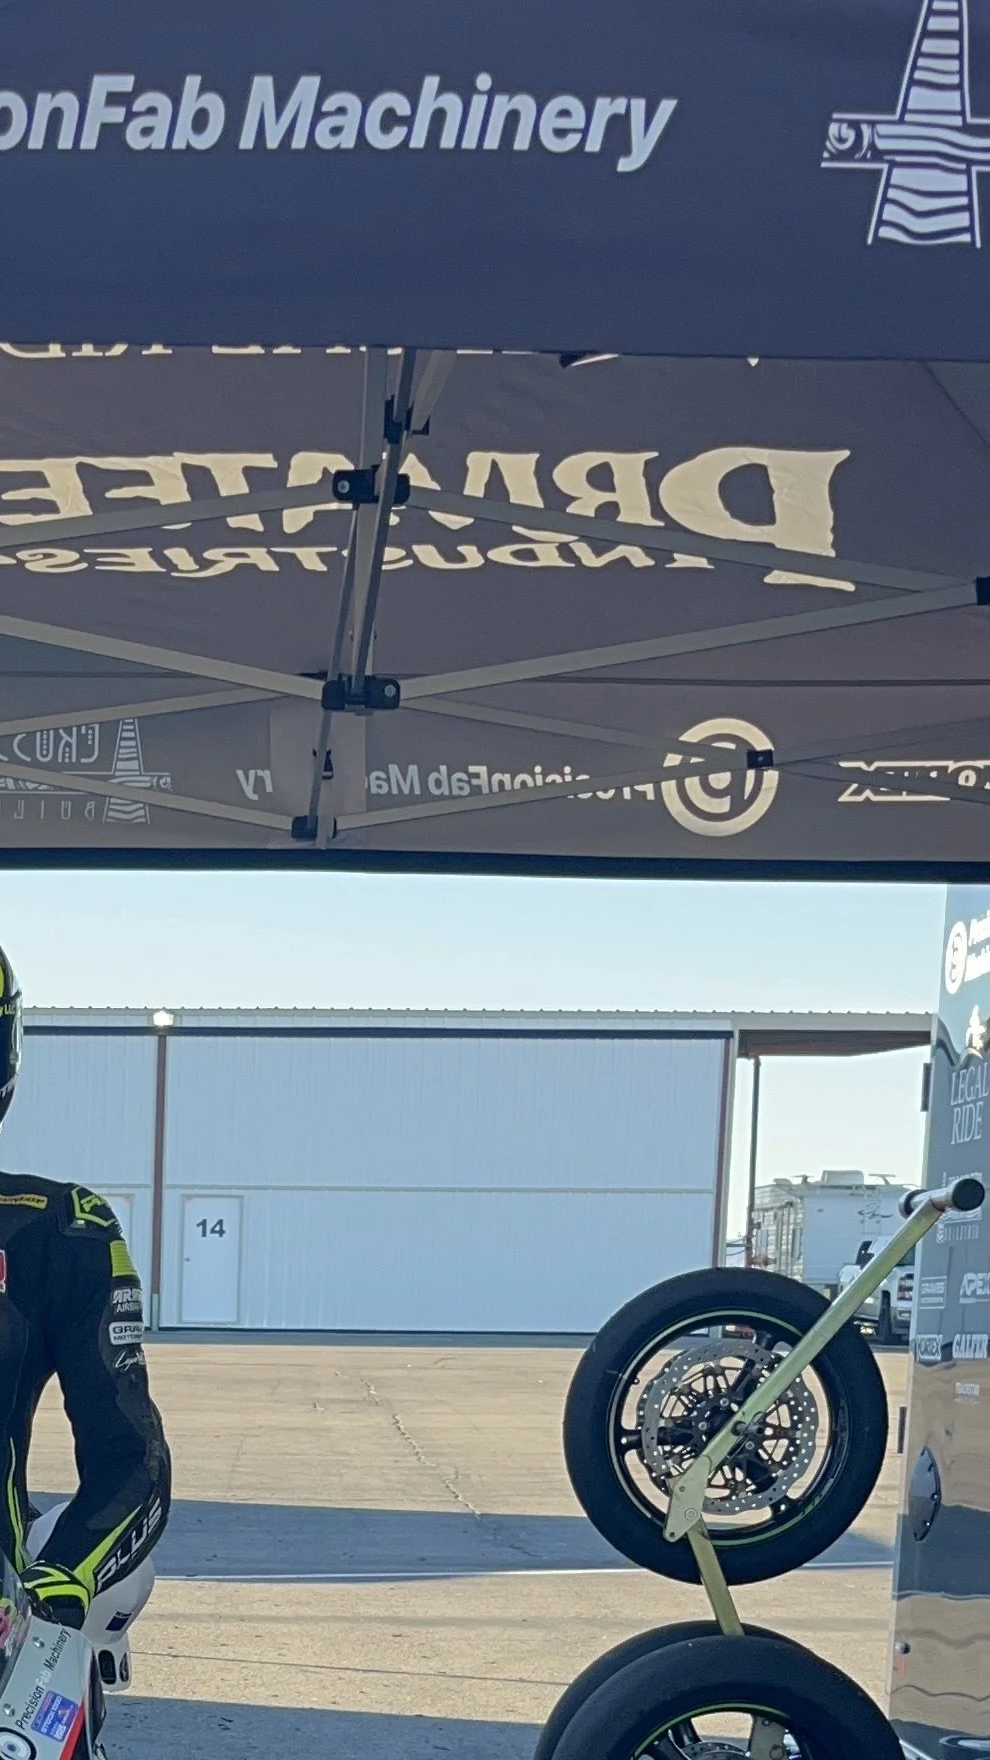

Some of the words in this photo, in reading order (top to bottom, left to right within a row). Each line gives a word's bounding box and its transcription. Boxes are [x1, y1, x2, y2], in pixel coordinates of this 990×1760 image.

[238, 72, 677, 173] Machinery
[949, 1062, 990, 1107] LEGAL
[950, 1101, 984, 1146] RIDE
[196, 1218, 226, 1239] 14
[15, 1685, 46, 1730] Precision
[43, 1628, 72, 1671] Machinery
